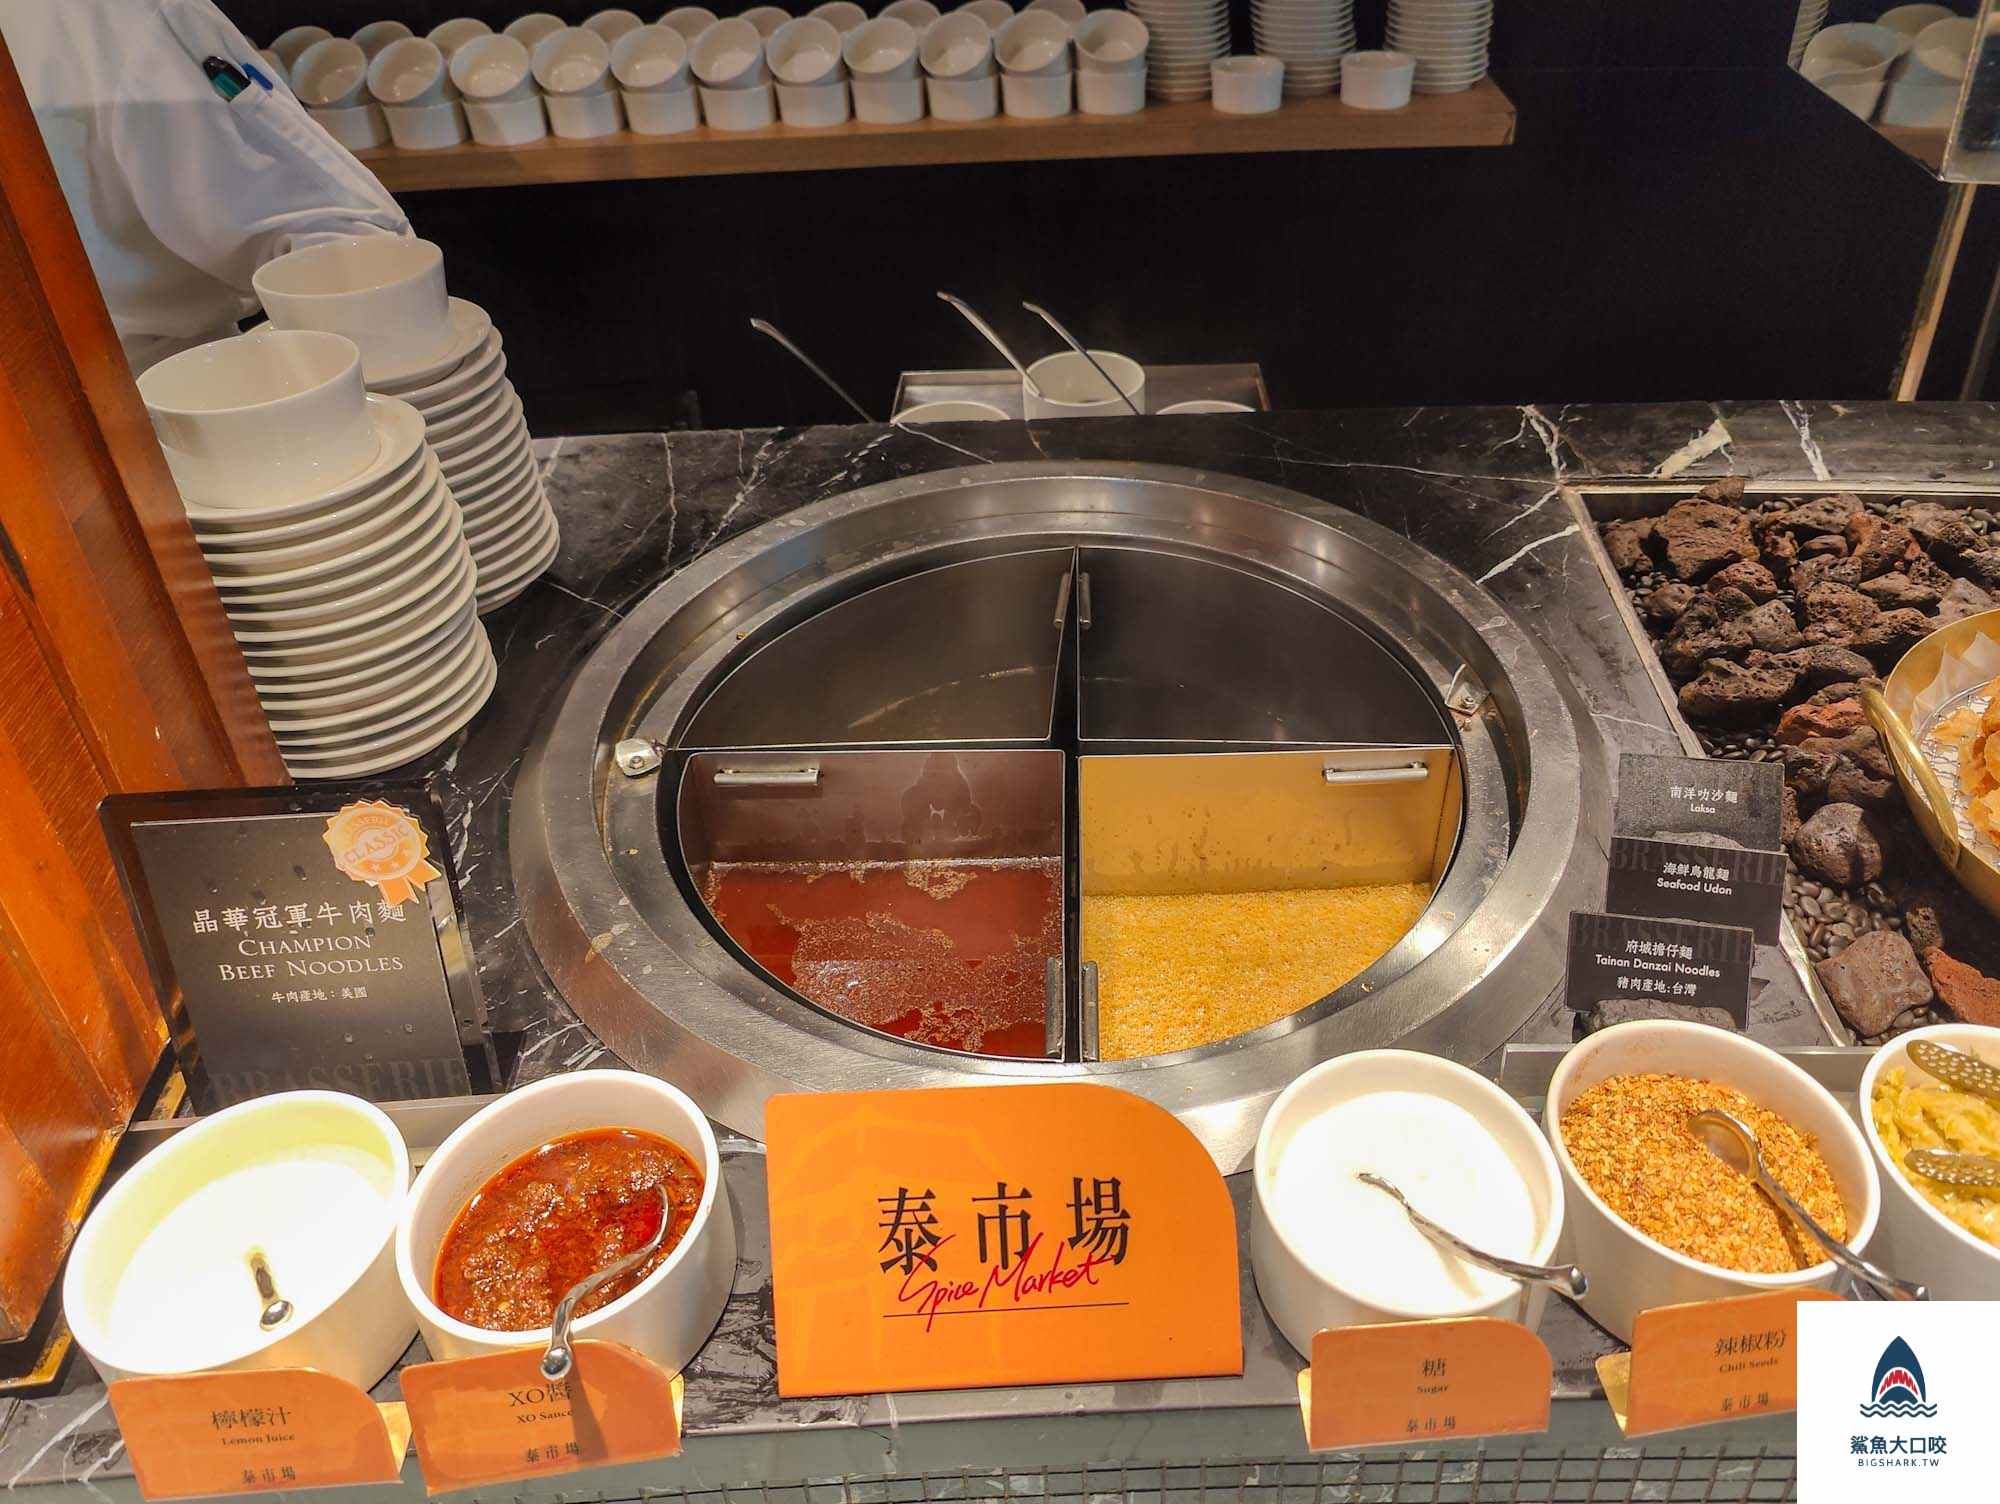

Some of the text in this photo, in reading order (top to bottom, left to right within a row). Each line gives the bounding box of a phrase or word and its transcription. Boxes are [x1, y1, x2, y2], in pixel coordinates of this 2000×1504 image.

[1670, 785, 1738, 804] 南洋叻沙麵
[1690, 803, 1716, 814] Laksa
[1656, 877, 1732, 895] Seafood Udon
[192, 900, 407, 934] 晶華冠軍牛肉麵
[238, 935, 372, 957] CHAMPION
[1625, 940, 1694, 960] 府城擔仔麵
[218, 956, 404, 981] BEEF NOODLES
[1595, 953, 1721, 978] Tainan Danzai Noodles
[878, 1176, 1131, 1275] 泰市場
[898, 1232, 1113, 1332] Spice Market
[1714, 1328, 1787, 1358] 辣椒粉
[1422, 1359, 1446, 1377] 糖
[1749, 1356, 1778, 1369] Seeds
[1417, 1384, 1448, 1395] Sugar
[1721, 1392, 1769, 1412] 泰市場
[211, 1407, 292, 1430] 檸檬汁
[516, 1408, 574, 1423] XO Sauce
[1406, 1416, 1456, 1433] 泰市場
[221, 1433, 295, 1446] Lemon Juice
[525, 1441, 581, 1463] 泰市場
[241, 1466, 296, 1485] 泰市場
